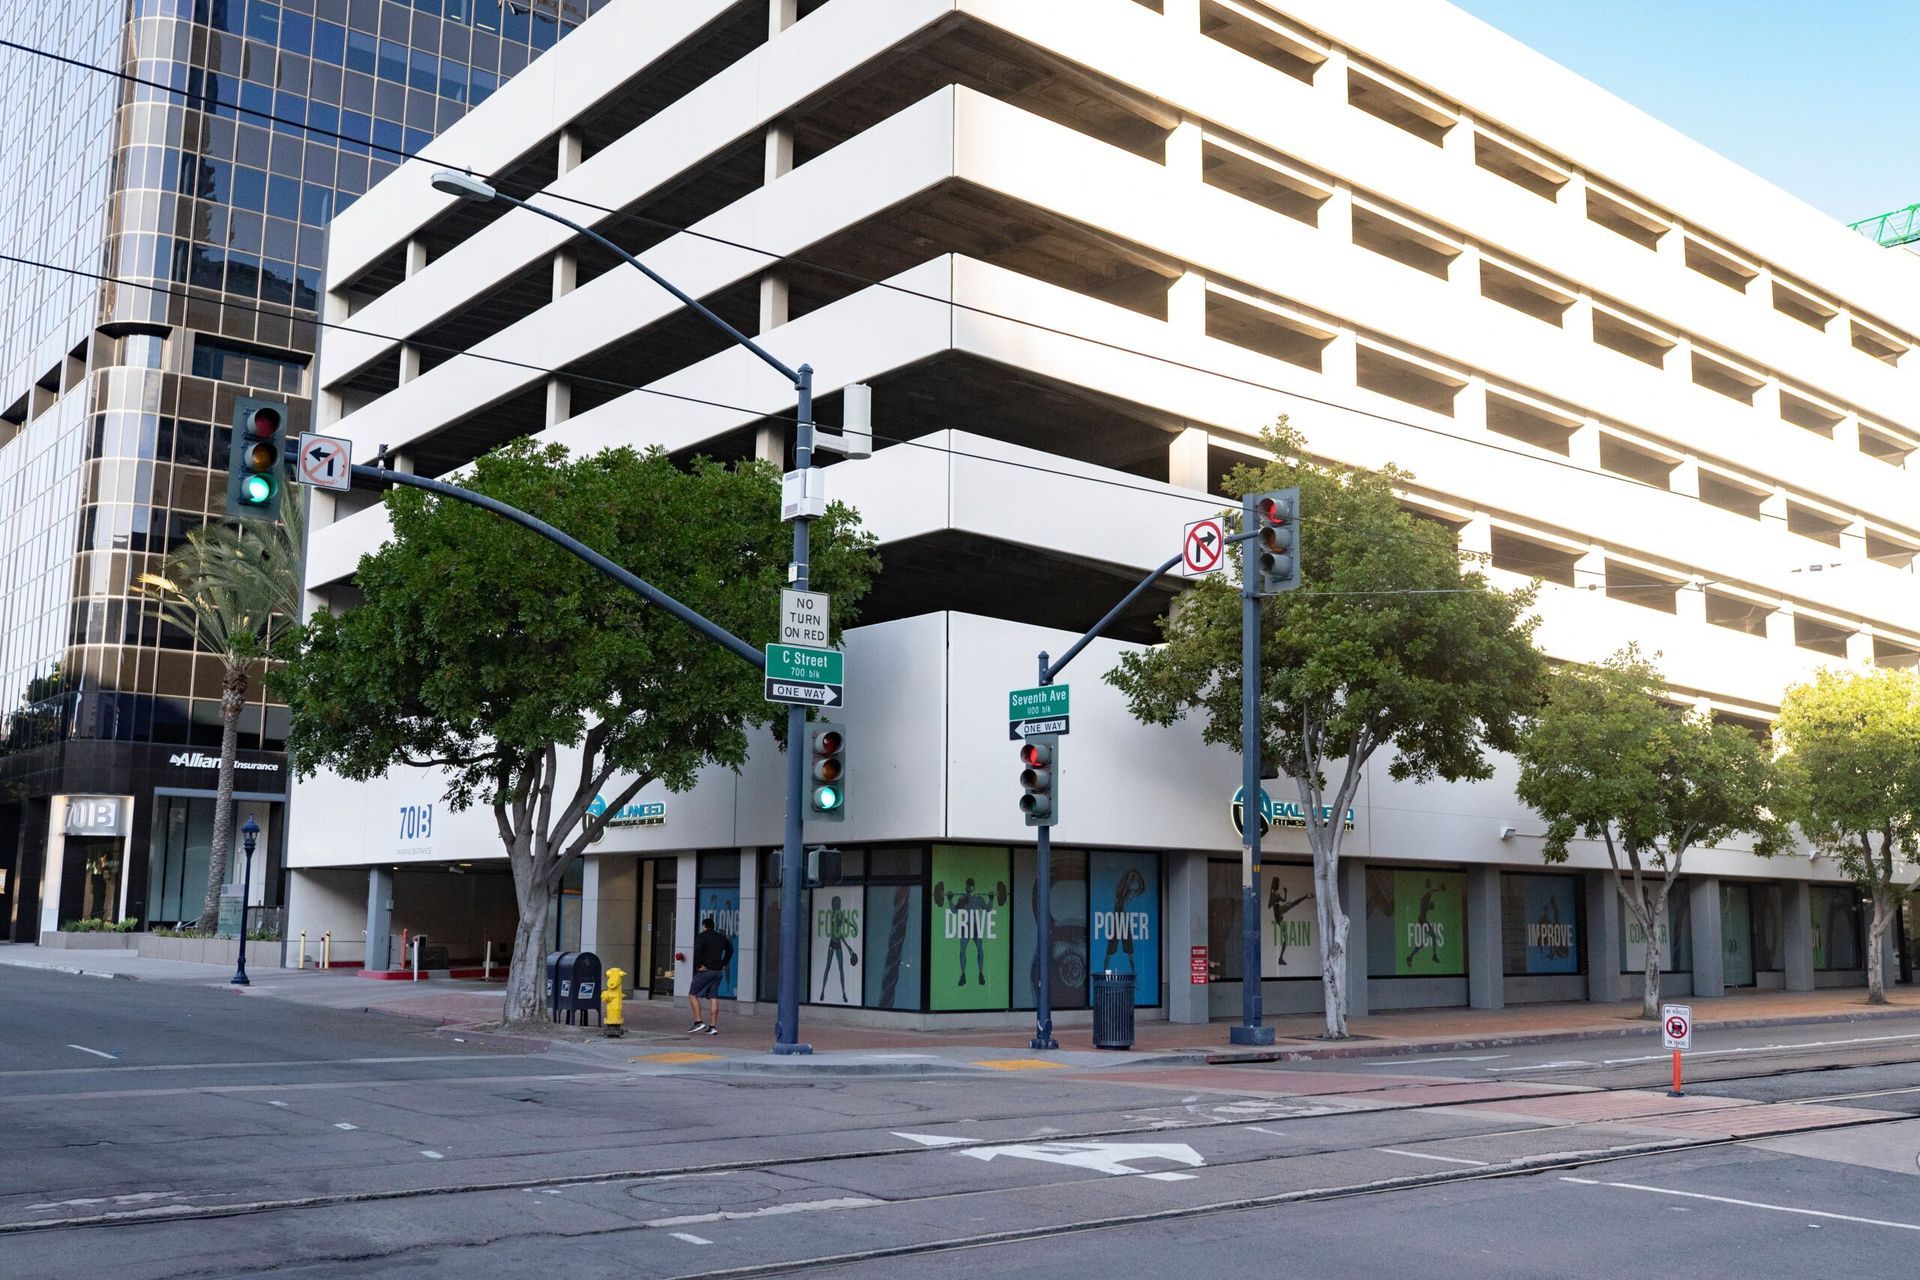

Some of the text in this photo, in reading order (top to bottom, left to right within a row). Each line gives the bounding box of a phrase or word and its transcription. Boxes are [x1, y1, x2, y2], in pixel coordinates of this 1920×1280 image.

[796, 598, 814, 609] NO
[789, 612, 821, 626] TURN
[784, 626, 825, 641] ON RED
[782, 650, 828, 668] C Street
[791, 667, 820, 678] 700 blk
[777, 685, 826, 699] ONE WAY
[1012, 689, 1067, 706] Seventh Ave
[1041, 704, 1052, 714] blk
[1023, 721, 1063, 734] ONE WAY
[177, 752, 279, 772] Allian Insurance
[818, 909, 859, 939] FOCUS
[944, 908, 998, 939] DRIVE
[1094, 911, 1149, 940] POWER
[1271, 920, 1311, 946] TRAIN
[1527, 923, 1573, 946] IMPROVE
